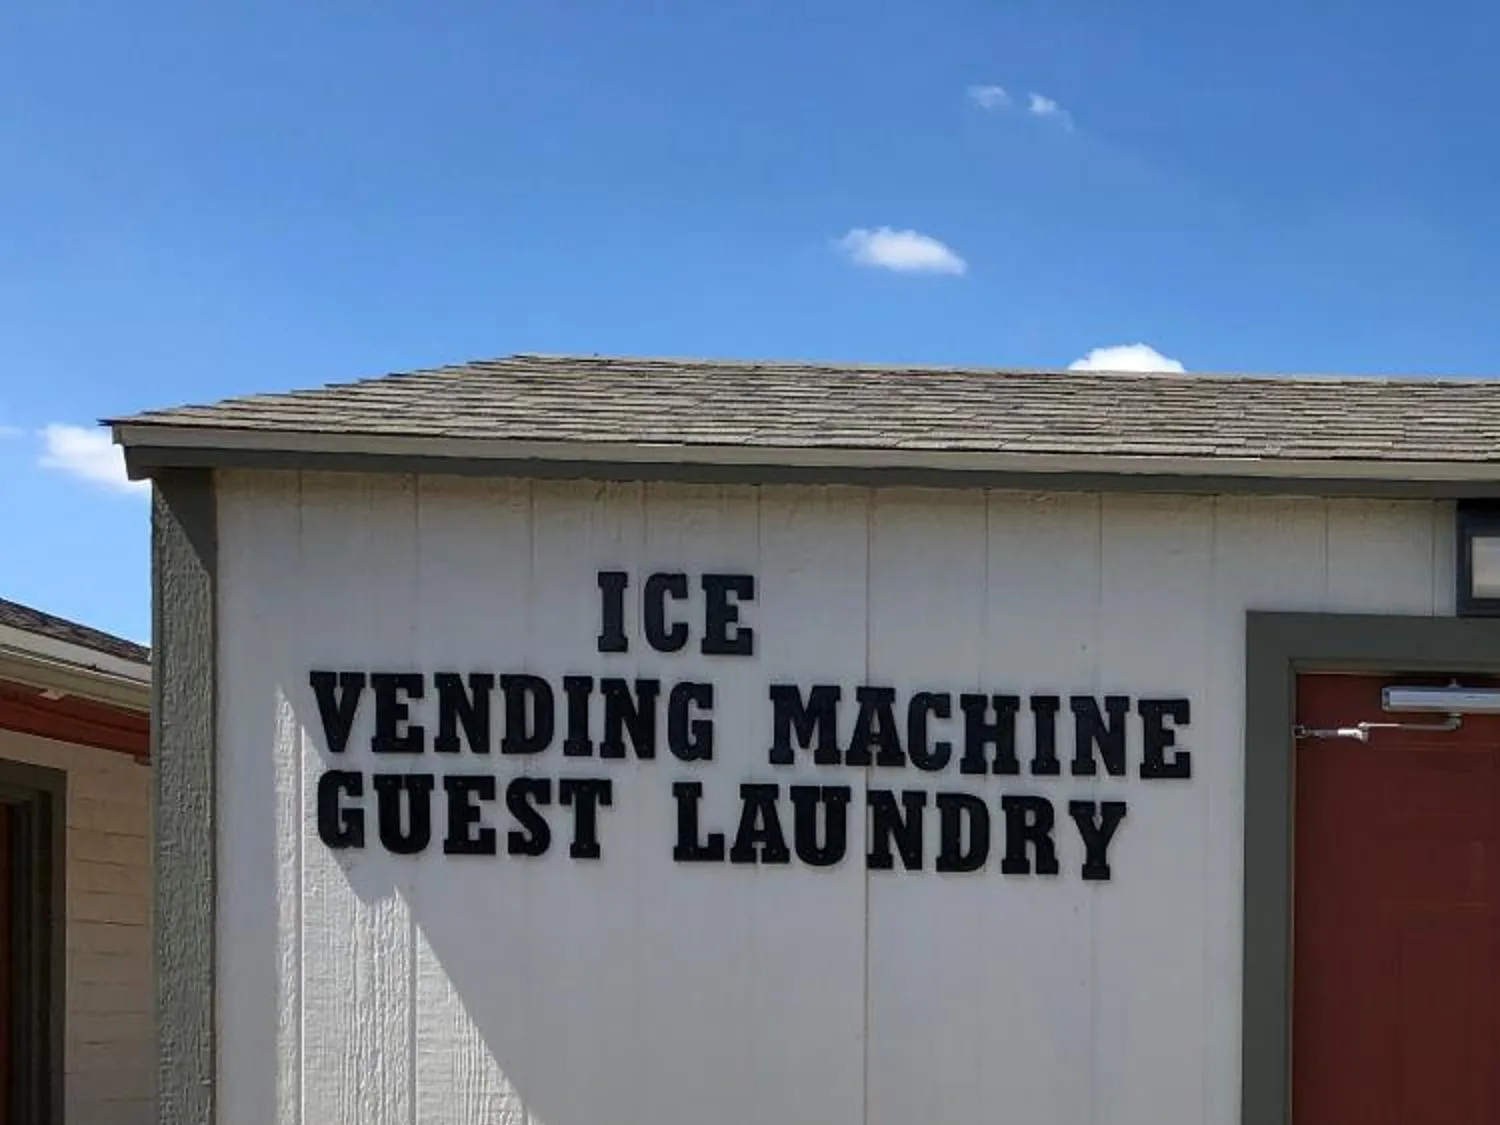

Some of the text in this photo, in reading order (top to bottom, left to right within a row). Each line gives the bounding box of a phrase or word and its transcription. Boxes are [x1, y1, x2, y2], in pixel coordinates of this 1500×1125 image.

[597, 571, 754, 655] ICE
[309, 671, 1191, 779] VENDING MACHINE
[317, 769, 1127, 880] GUEST LAUNDRY
